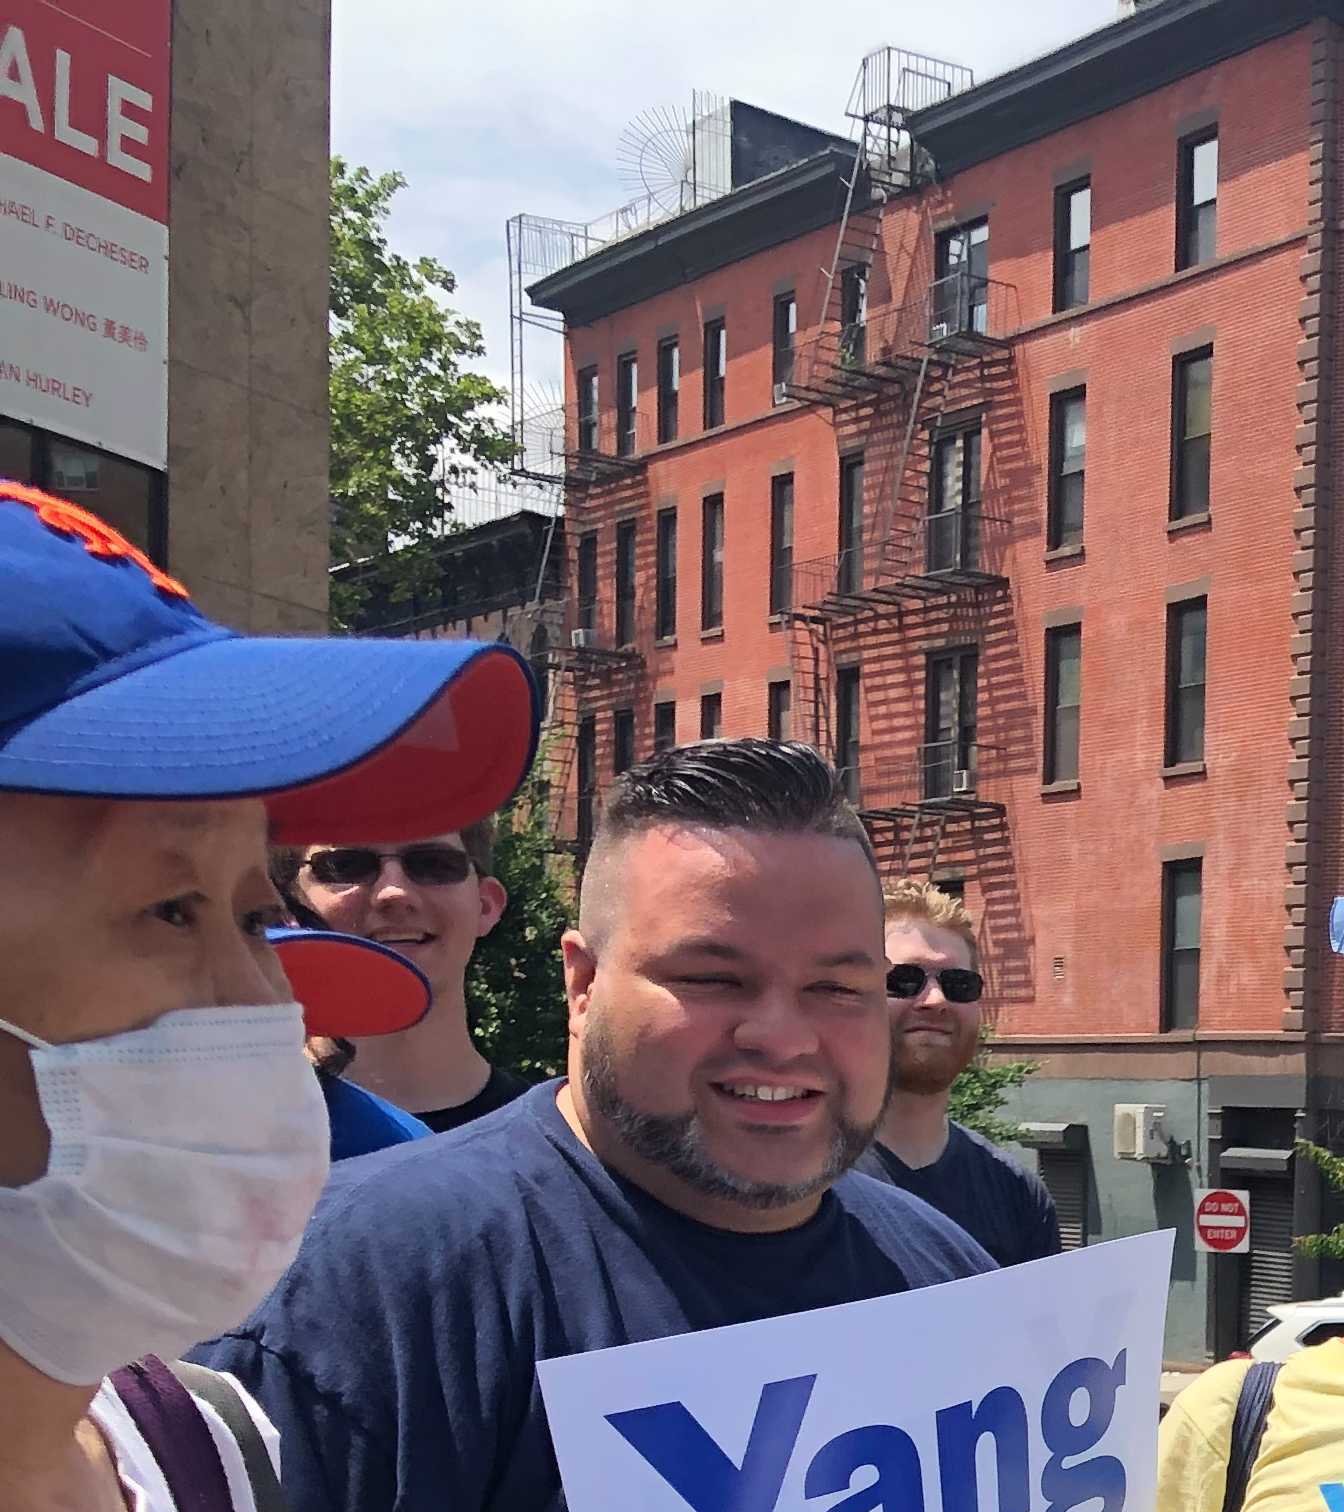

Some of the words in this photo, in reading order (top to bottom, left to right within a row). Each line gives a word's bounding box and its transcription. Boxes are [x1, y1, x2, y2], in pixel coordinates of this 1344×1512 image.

[0, 25, 152, 184] ALE
[62, 221, 149, 274] DECHESER
[43, 296, 98, 332] WONG
[25, 370, 93, 407] HURLEY
[1207, 1228, 1237, 1240] ENTER
